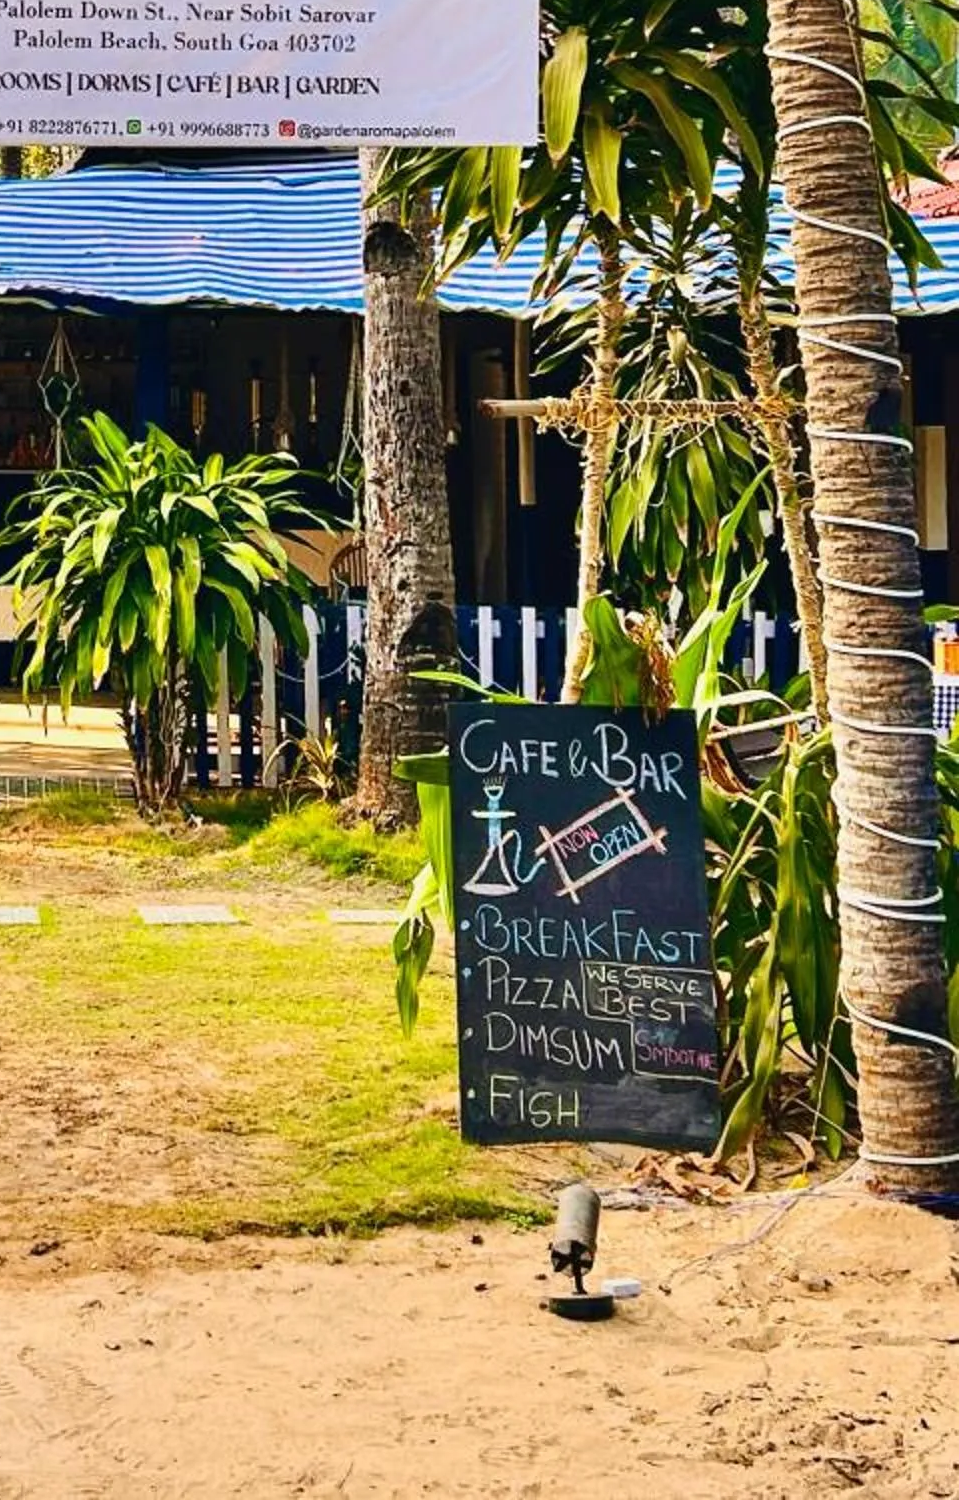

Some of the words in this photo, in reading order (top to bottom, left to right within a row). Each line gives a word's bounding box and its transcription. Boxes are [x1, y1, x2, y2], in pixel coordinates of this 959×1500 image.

[81, 1, 139, 21] Down
[187, 2, 235, 22] Near
[240, 3, 292, 23] Sobit
[299, 4, 377, 24] Sarovar
[13, 29, 92, 49] Palolem
[100, 31, 168, 51] Beach,
[173, 31, 233, 51] South
[239, 32, 278, 51] Goa
[284, 33, 357, 53] 403702
[77, 73, 152, 92] DORMS
[166, 72, 222, 93] CAFÉ
[237, 75, 280, 94] BAR
[296, 76, 381, 95] GARDEN
[146, 122, 175, 137] +91
[180, 121, 270, 138] 9996688773
[297, 122, 456, 139] @gardenaromapalolem
[568, 739, 588, 778] &
[554, 823, 599, 860] NOW
[589, 820, 641, 865] OPEN
[477, 956, 581, 1010] PIZZA
[482, 1011, 625, 1071] DIMSUM
[491, 1074, 580, 1129] FISH
